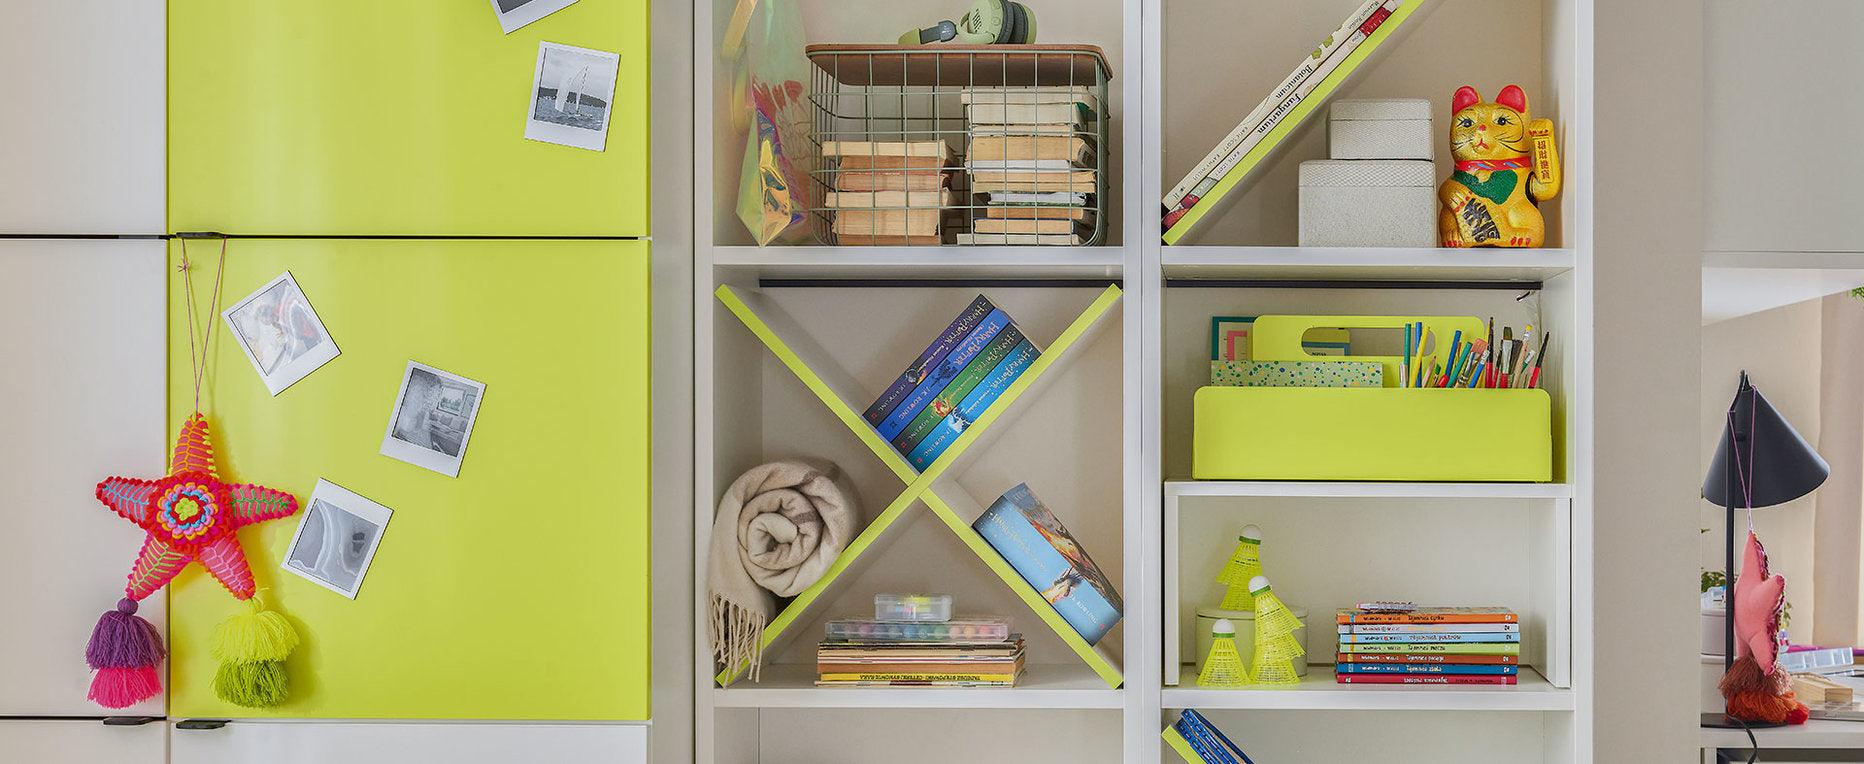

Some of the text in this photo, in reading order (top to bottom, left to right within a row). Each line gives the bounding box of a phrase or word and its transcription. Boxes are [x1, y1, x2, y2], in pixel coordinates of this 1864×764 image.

[1275, 63, 1313, 102] Botanicum
[1255, 90, 1302, 136] Fungarium
[961, 303, 985, 327] HARRY
[942, 321, 967, 346] POTTER
[972, 320, 999, 347] HARRY
[991, 333, 1014, 356] HARRY
[952, 340, 980, 369] POTTER
[972, 350, 997, 376] POTTER
[1008, 349, 1030, 372] HARRY
[989, 365, 1014, 391] POTTER
[897, 395, 922, 420] ROWLING
